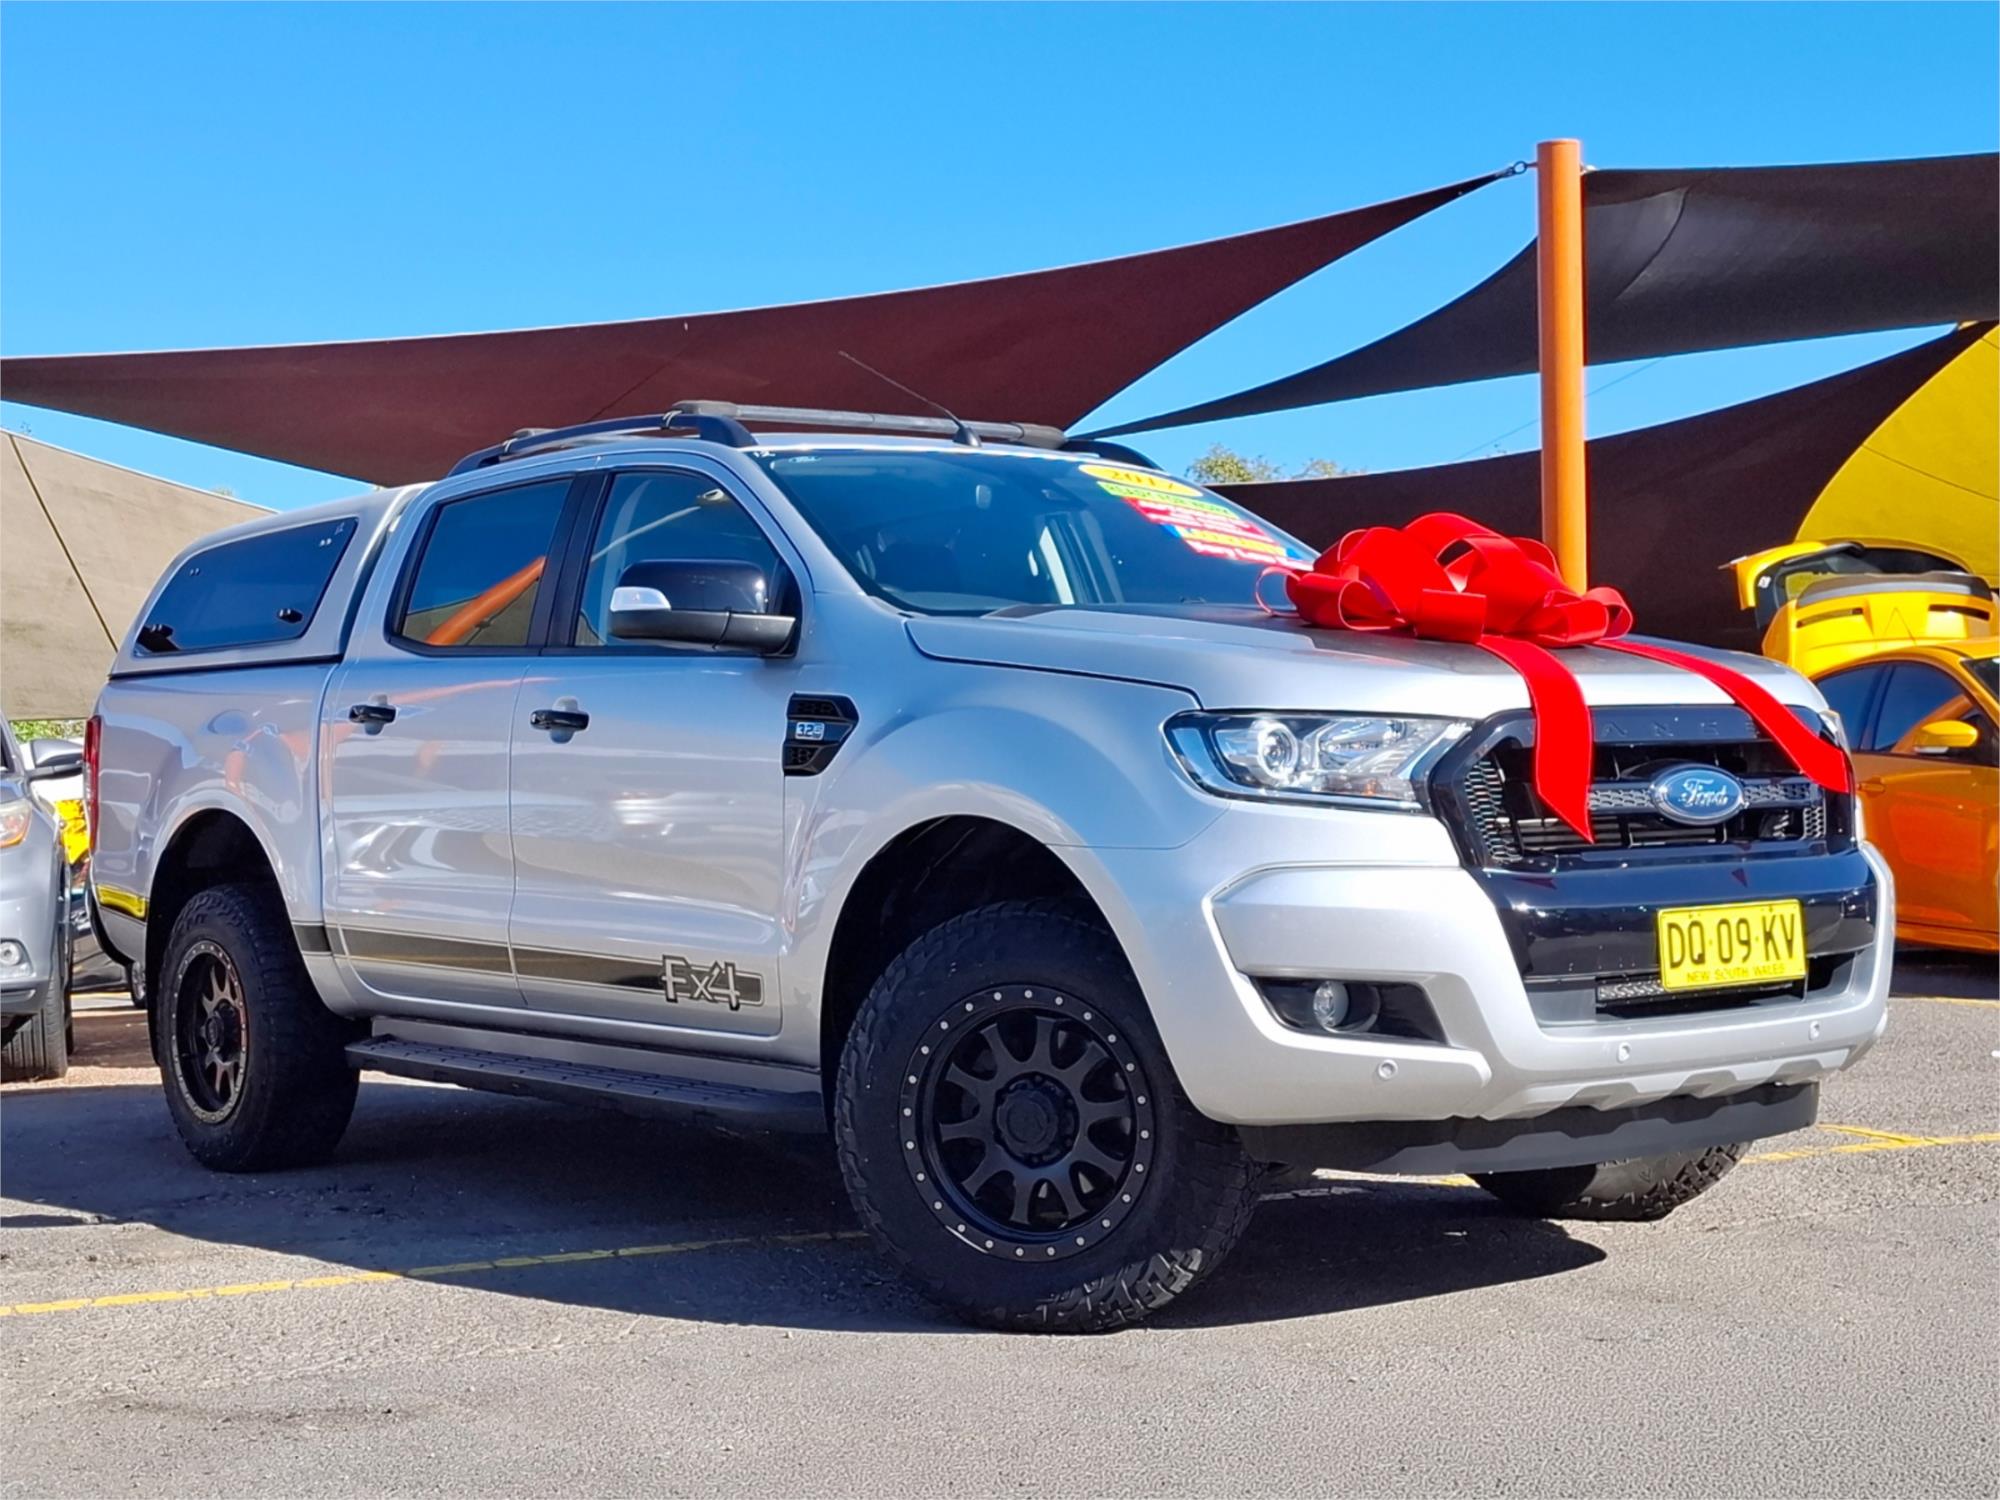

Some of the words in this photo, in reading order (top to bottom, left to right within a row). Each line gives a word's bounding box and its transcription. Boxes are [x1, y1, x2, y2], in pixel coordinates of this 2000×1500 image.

[1680, 778, 1729, 807] Ford
[1686, 970, 1710, 983] NEW
[1715, 966, 1748, 981] SOUTH
[1753, 963, 1785, 977] WALES
